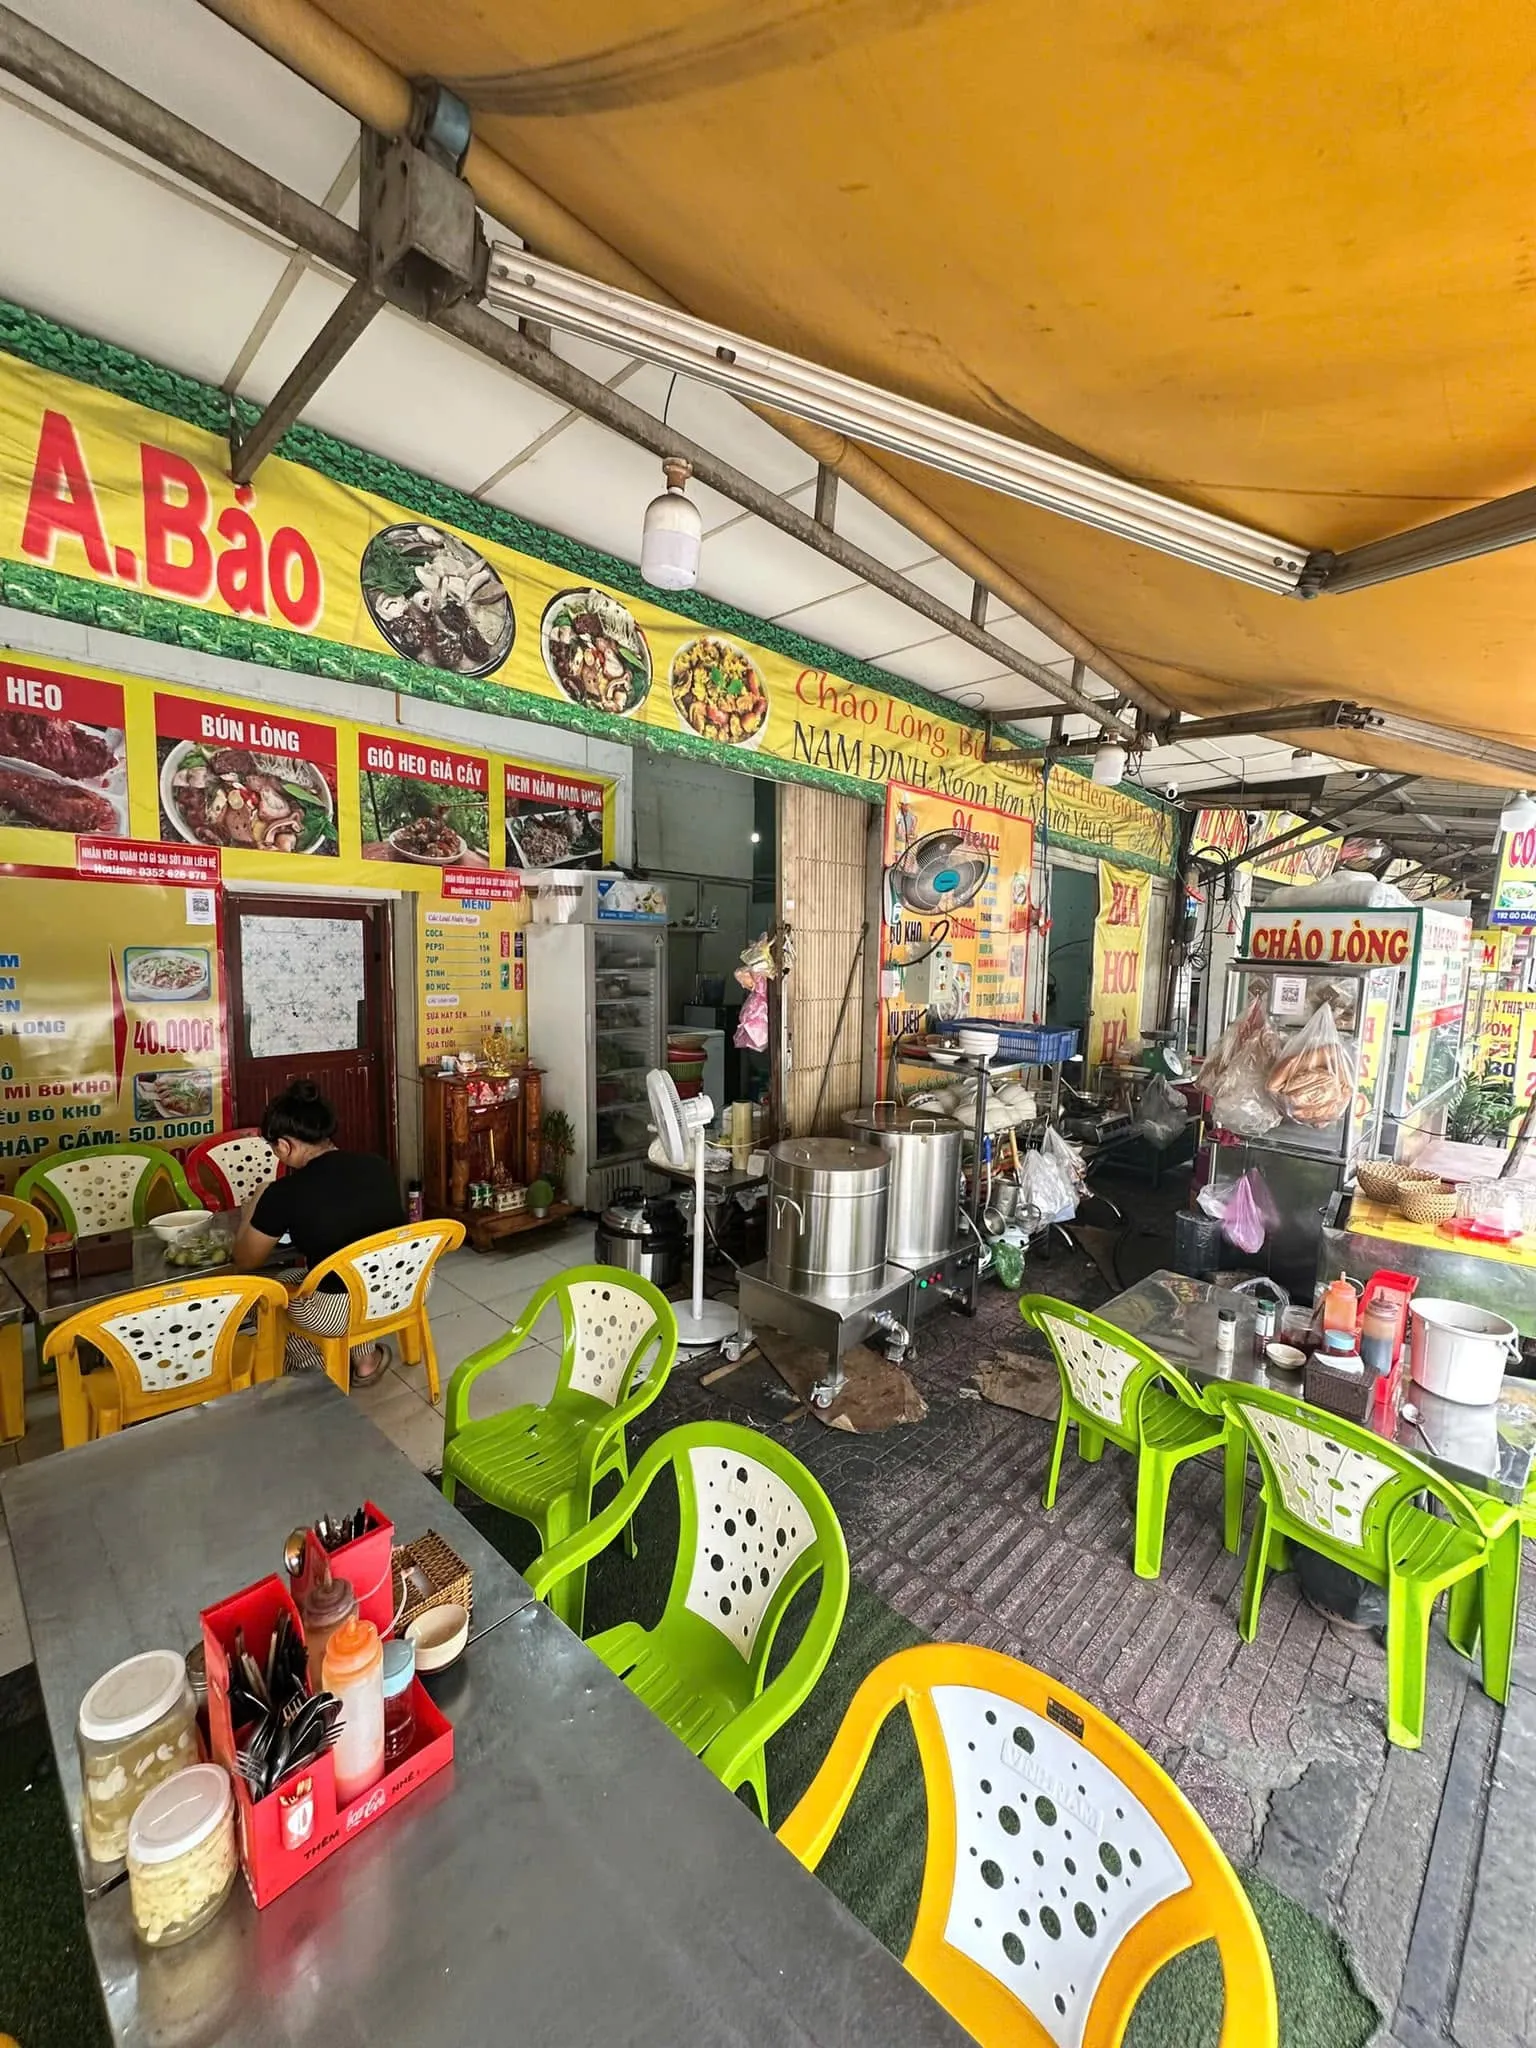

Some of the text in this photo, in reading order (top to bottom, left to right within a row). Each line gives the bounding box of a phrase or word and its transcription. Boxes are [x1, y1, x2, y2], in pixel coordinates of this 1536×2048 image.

[6, 676, 63, 712] HEO
[795, 668, 879, 725] Cháo
[200, 714, 300, 753] BÚN LÒNG
[792, 720, 862, 777] NAM
[367, 745, 394, 769] GIÒ
[398, 753, 426, 776] HEO
[430, 756, 453, 781] GIẢ
[506, 773, 530, 793] NEM
[557, 784, 579, 802] NAM
[461, 899, 492, 911] MENU
[1252, 919, 1323, 960] CHÁO
[1330, 919, 1409, 964] LÒNG
[12, 1020, 66, 1035] LONG
[5, 1083, 31, 1100] MÌ
[72, 1079, 111, 1096] KHO
[62, 1104, 101, 1120] KHO
[129, 1119, 215, 1143] 50.000đ
